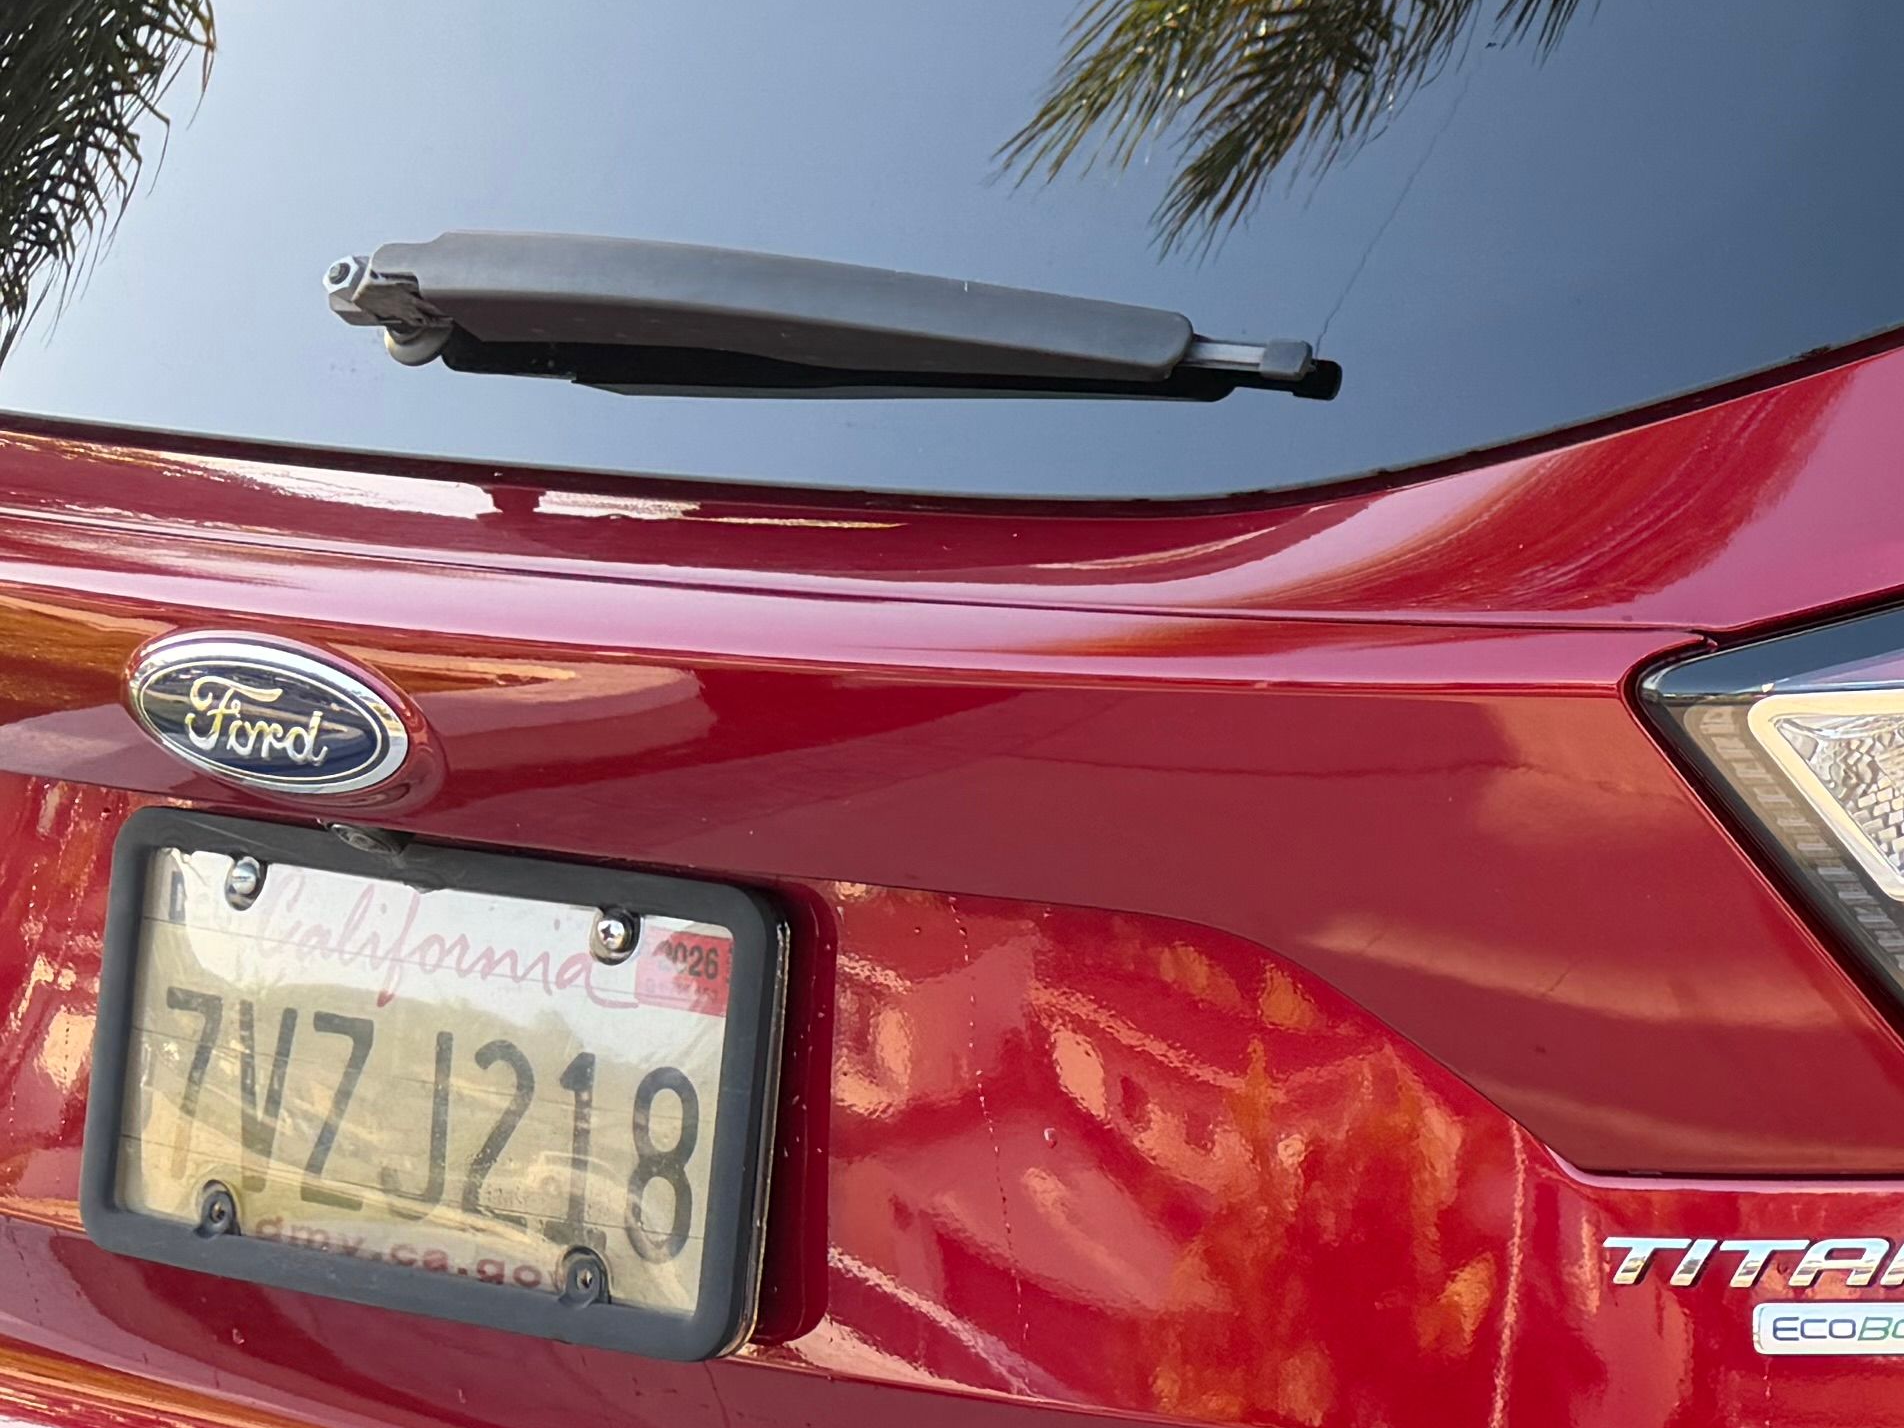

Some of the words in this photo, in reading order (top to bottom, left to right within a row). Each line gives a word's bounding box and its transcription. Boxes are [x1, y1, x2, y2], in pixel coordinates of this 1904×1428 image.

[185, 675, 328, 764] Ford
[258, 871, 640, 1009] California
[166, 986, 700, 1263] 7VZJ218
[254, 1216, 556, 1287] dmv.ca.go
